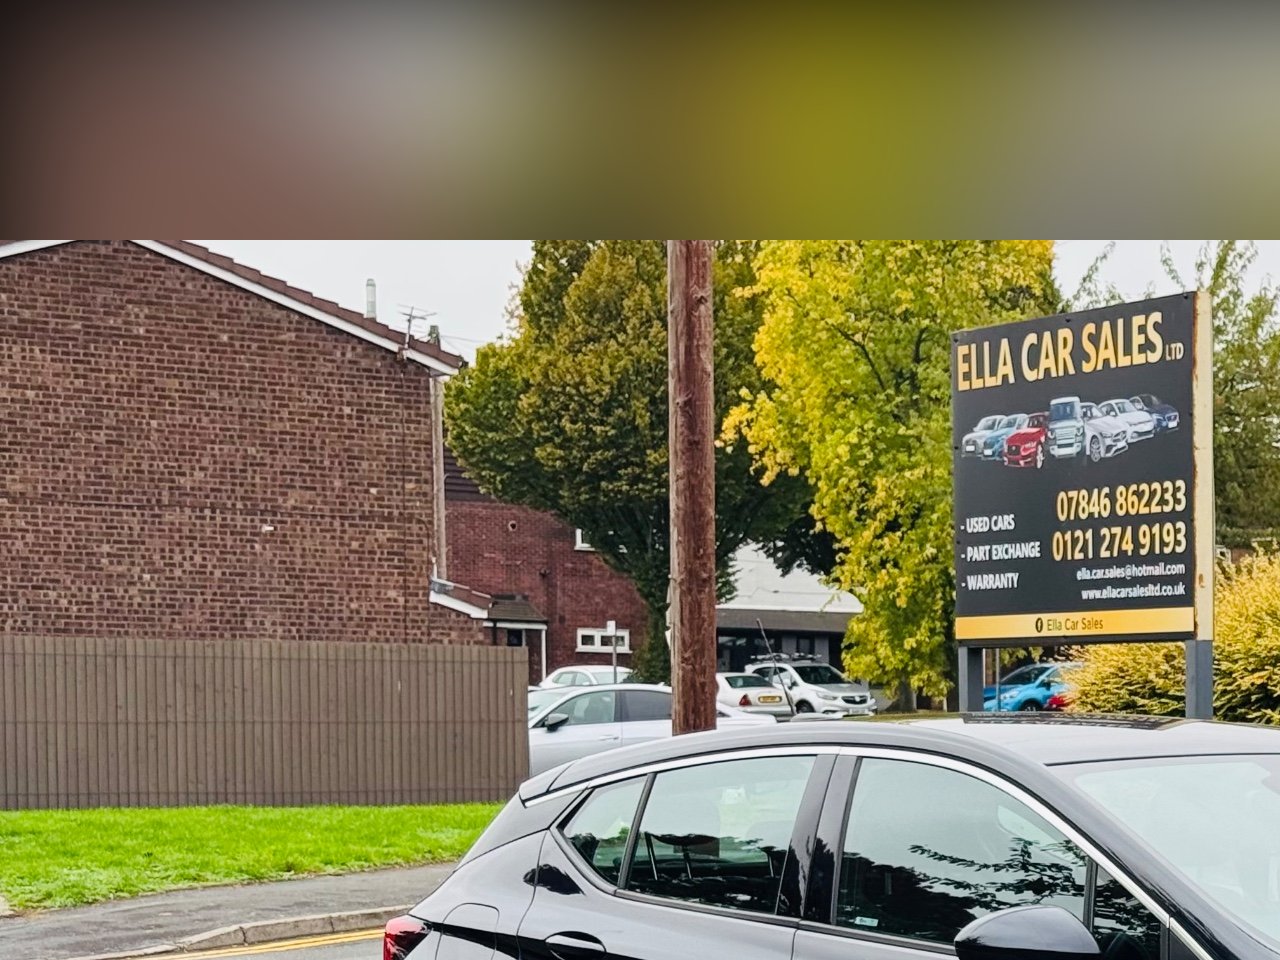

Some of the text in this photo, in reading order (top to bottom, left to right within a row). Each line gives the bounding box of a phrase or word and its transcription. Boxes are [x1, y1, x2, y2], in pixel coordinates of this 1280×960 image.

[957, 311, 1184, 392] ELLA CAR SALES LTD
[1056, 479, 1187, 522] 07846 862233
[966, 516, 990, 533] USED
[990, 513, 1015, 532] CARS
[1052, 520, 1187, 562] 0121 274 9193
[966, 545, 990, 563] PART
[991, 541, 1041, 561] EXCHANGE
[1076, 561, 1186, 581] ella.car.sales@hotmail.com
[967, 572, 1019, 591] WARRANTY
[1081, 581, 1186, 600] www.ellacarsalesltd.co.uk
[1047, 618, 1062, 632] Ella
[1064, 617, 1079, 631] Car
[1081, 616, 1104, 631] Sales
